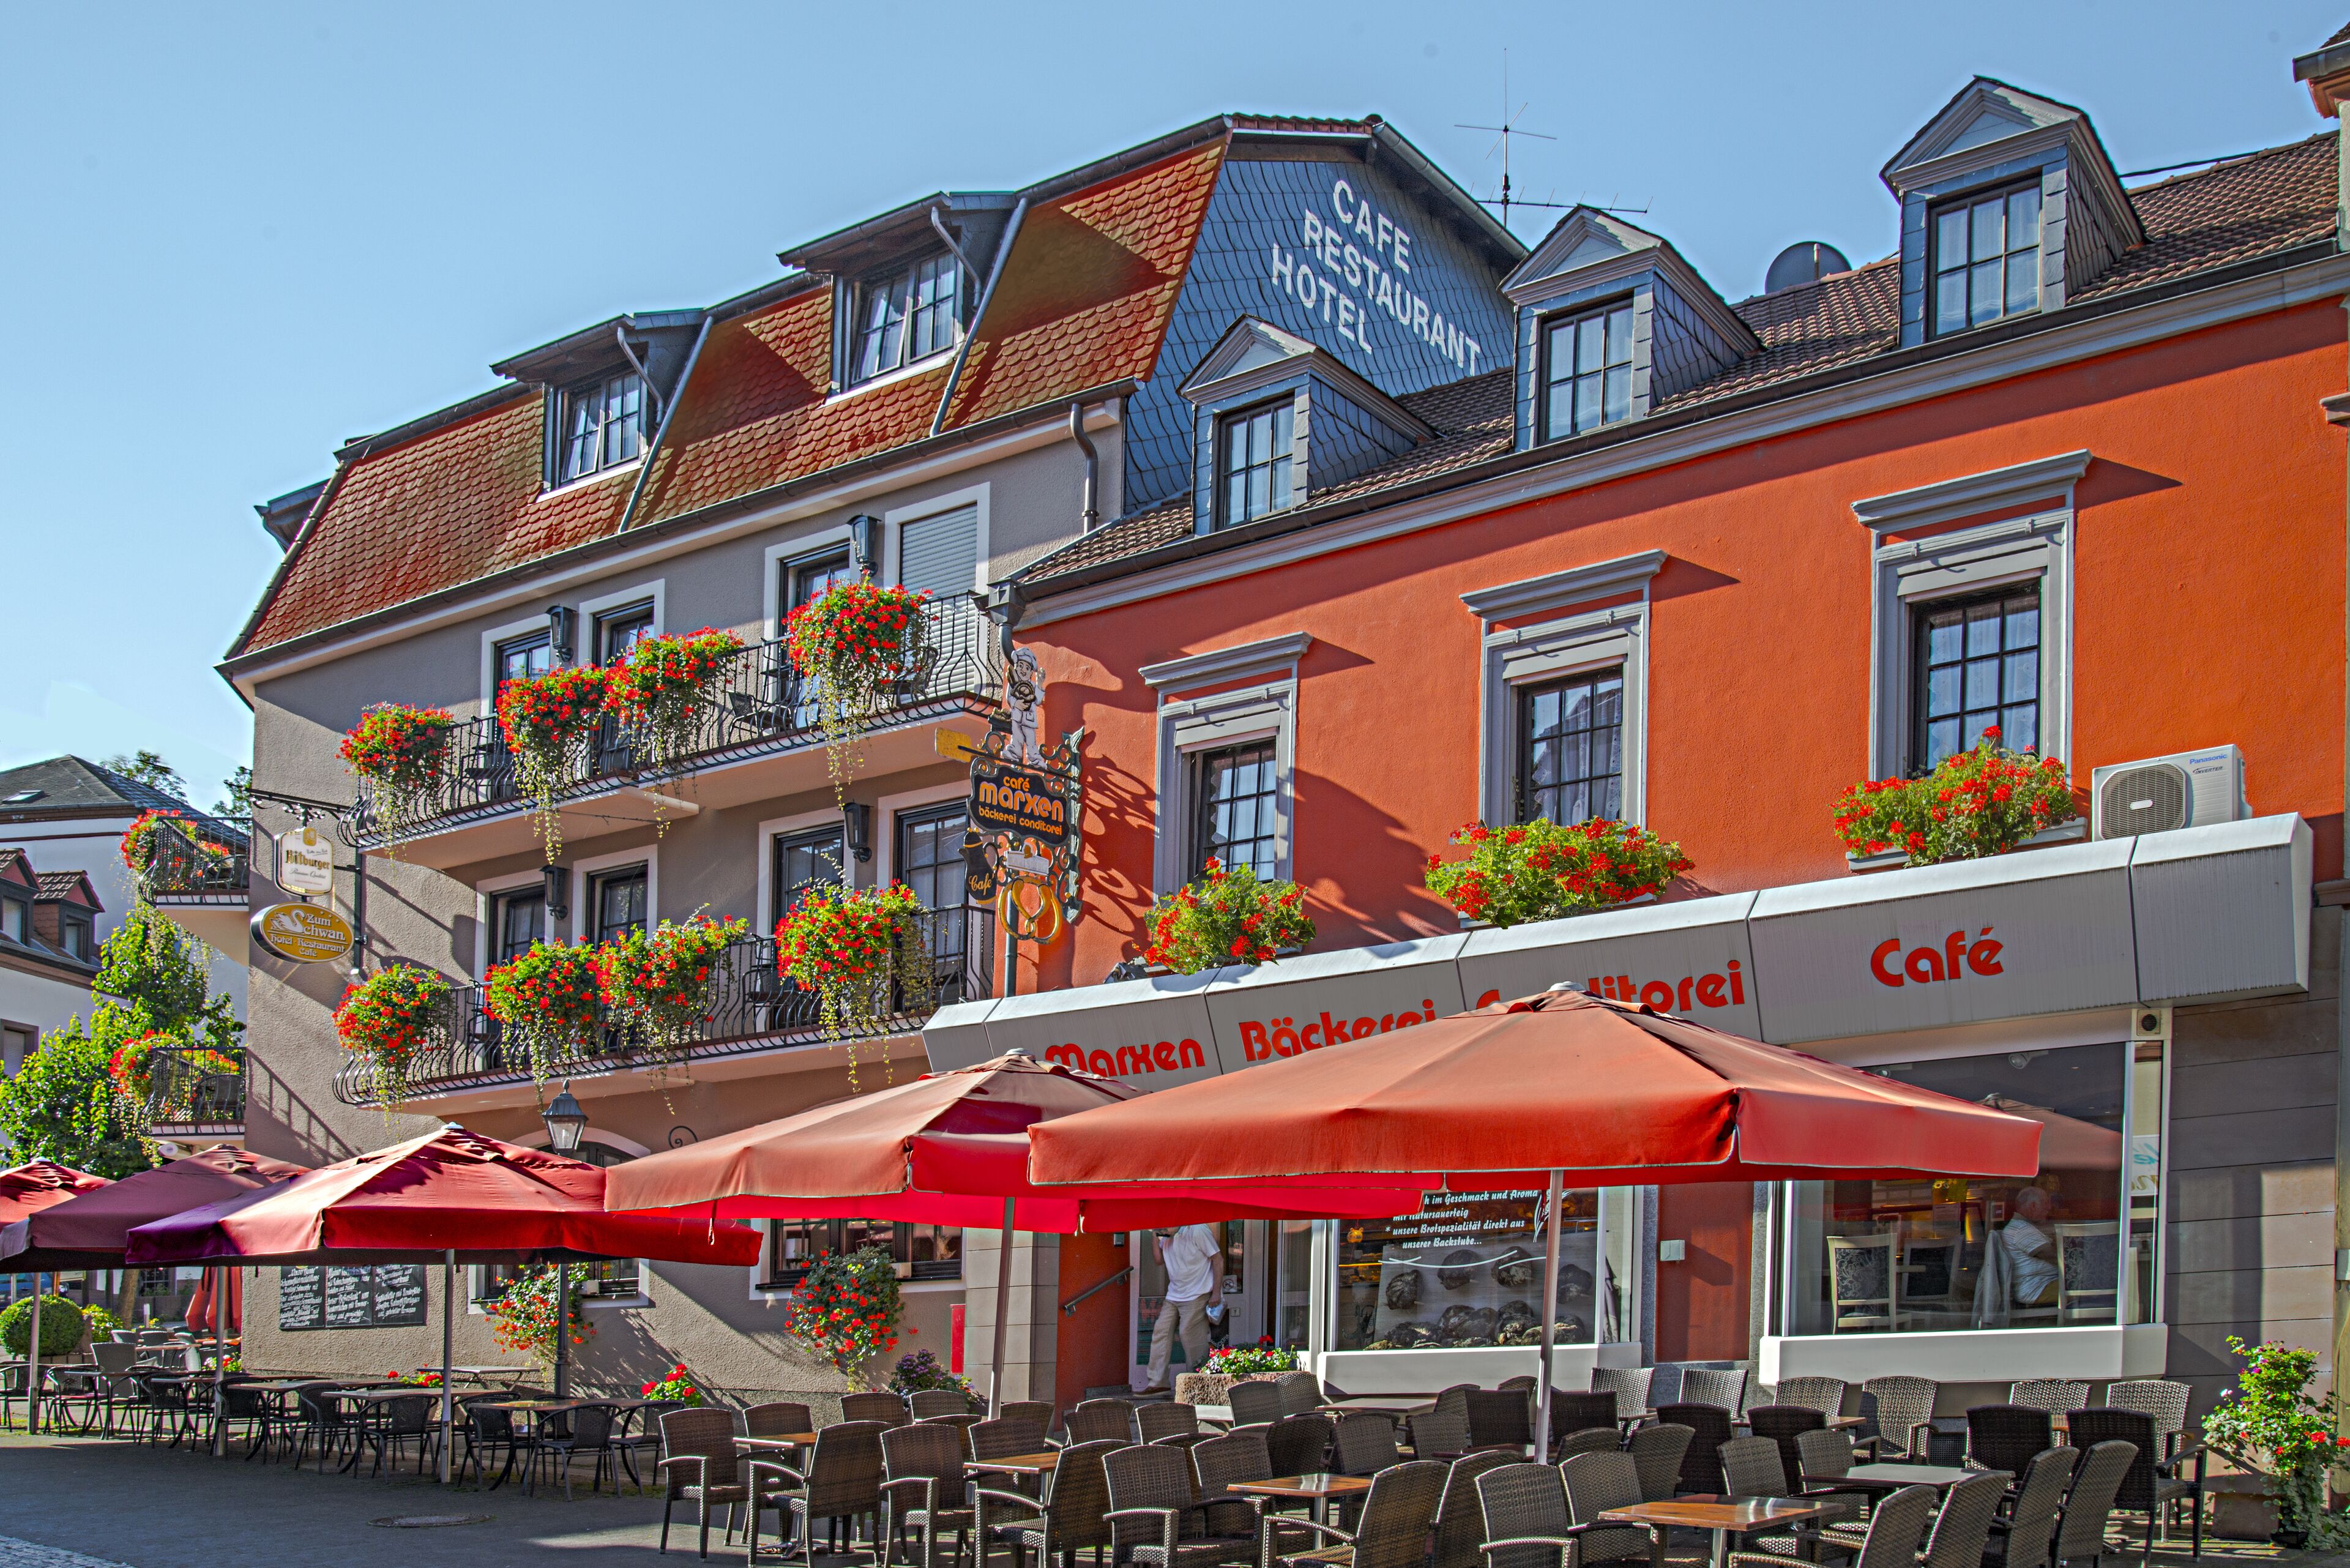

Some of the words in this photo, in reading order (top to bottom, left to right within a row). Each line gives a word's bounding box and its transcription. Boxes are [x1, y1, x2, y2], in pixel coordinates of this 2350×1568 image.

[1333, 180, 1410, 274] CAFE
[1272, 243, 1372, 354] HOTEL
[1305, 209, 1480, 376] RESTAURANT
[2189, 753, 2227, 764] Panasonic
[1004, 776, 1030, 791] café
[979, 781, 1064, 822] marxen
[979, 805, 1016, 824] bäckerei
[1019, 817, 1062, 836] conditorei
[285, 849, 330, 870] Bitburger
[969, 873, 994, 895] Café
[307, 913, 331, 926] Zum
[297, 938, 345, 953] Restaurant
[1870, 927, 2004, 987] Café
[1432, 1195, 1442, 1204] im
[1445, 1191, 1489, 1204] Geschmack
[1491, 1190, 1507, 1200] und
[1510, 1189, 1539, 1199] Aroma
[1393, 1226, 1418, 1235] unsere
[1420, 1221, 1481, 1234] Brotspezialität
[1483, 1219, 1508, 1230] direkt
[1402, 1239, 1431, 1249] unserer
[1433, 1236, 1482, 1247] Backstube...
